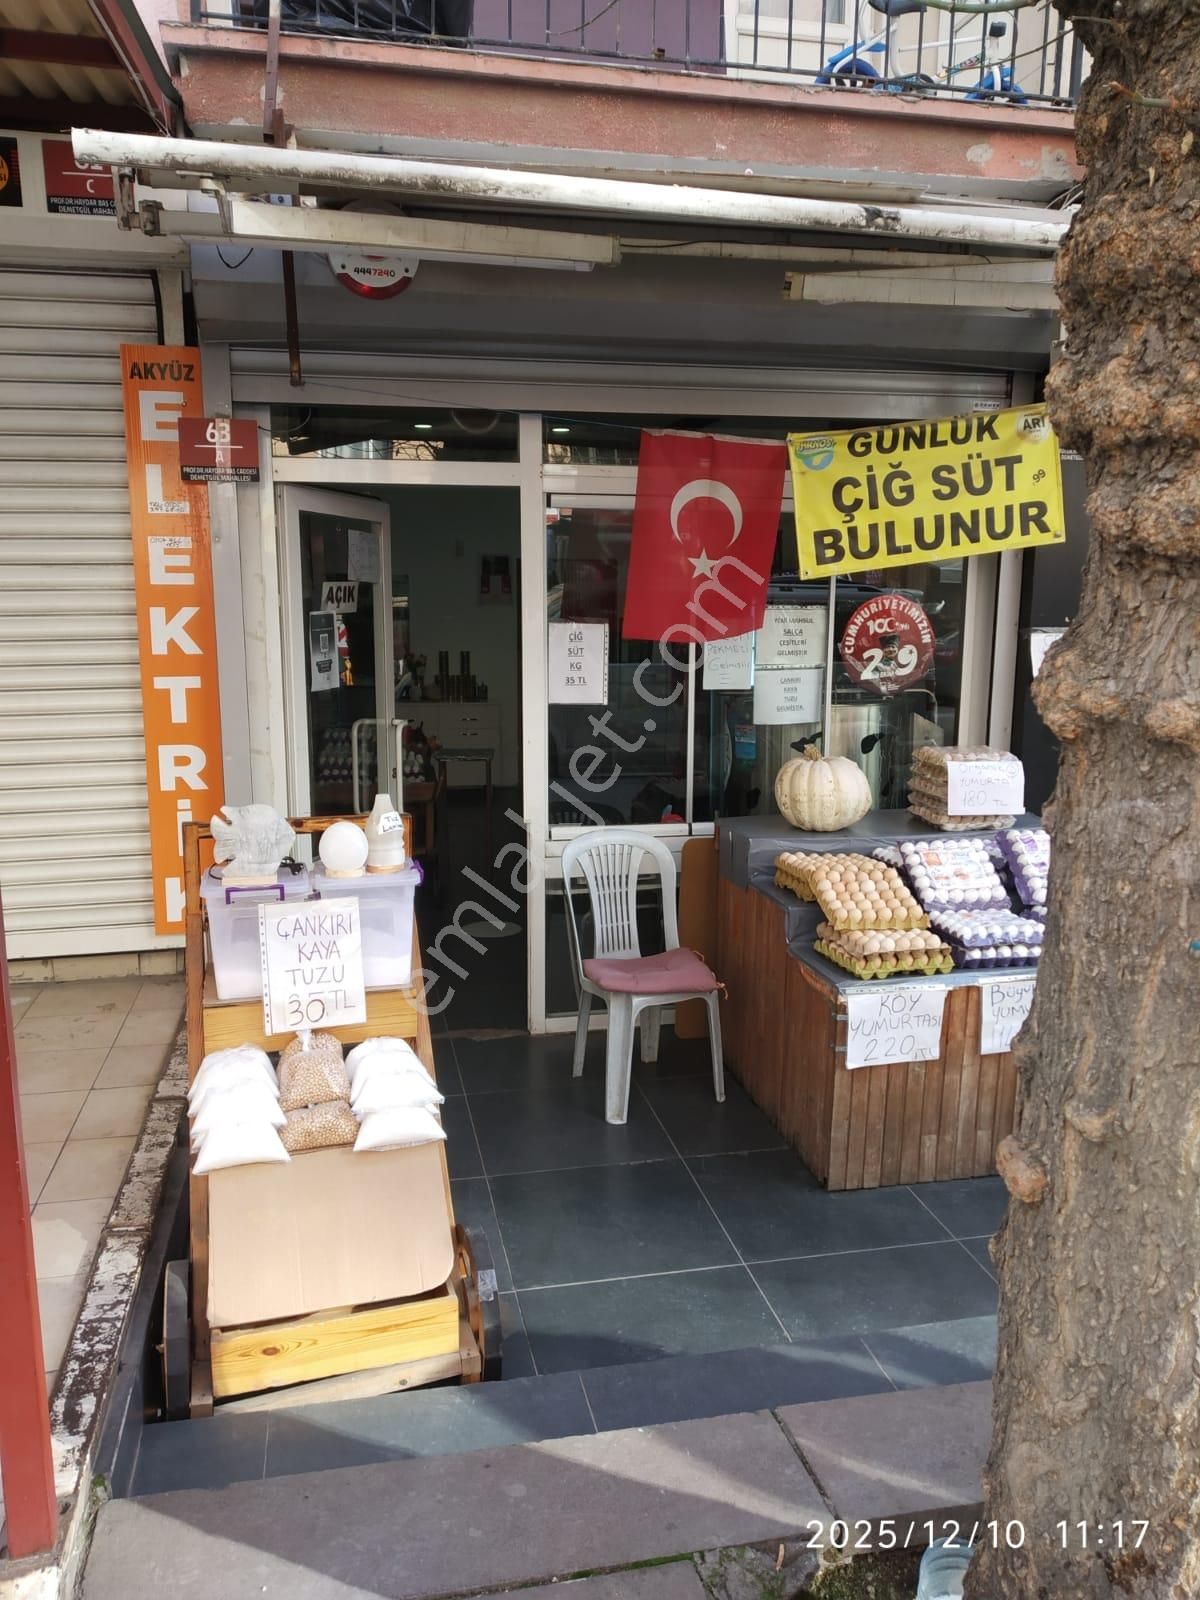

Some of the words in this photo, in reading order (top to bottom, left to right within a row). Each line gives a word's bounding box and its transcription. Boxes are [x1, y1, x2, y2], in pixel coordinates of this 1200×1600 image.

[58, 206, 91, 215] DEMETGÜL
[353, 266, 396, 278] 4447240
[129, 360, 195, 381] AKYÜZ
[206, 421, 231, 443] 63
[847, 413, 1000, 457] GÜNLÜK
[832, 461, 915, 523] ÇİĞ
[931, 453, 1023, 500] SÜT
[813, 501, 1051, 565] BULUNUR
[326, 586, 356, 608] AÇIK
[568, 632, 583, 642] ÇİĞ
[783, 628, 803, 636] SALÇA
[844, 598, 932, 654] CUMHURİYETİMİZİN
[567, 646, 584, 656] SÜT
[569, 662, 582, 670] KG
[860, 645, 918, 680] 29
[577, 676, 587, 684] TL
[276, 912, 353, 940] ÇANKIRI
[298, 941, 341, 963] KAYA
[285, 964, 345, 987] TUZU
[332, 989, 357, 1010] TL
[879, 991, 924, 1016] KÖY
[850, 1013, 941, 1040] YUMURTASI
[863, 1035, 916, 1062] 220
